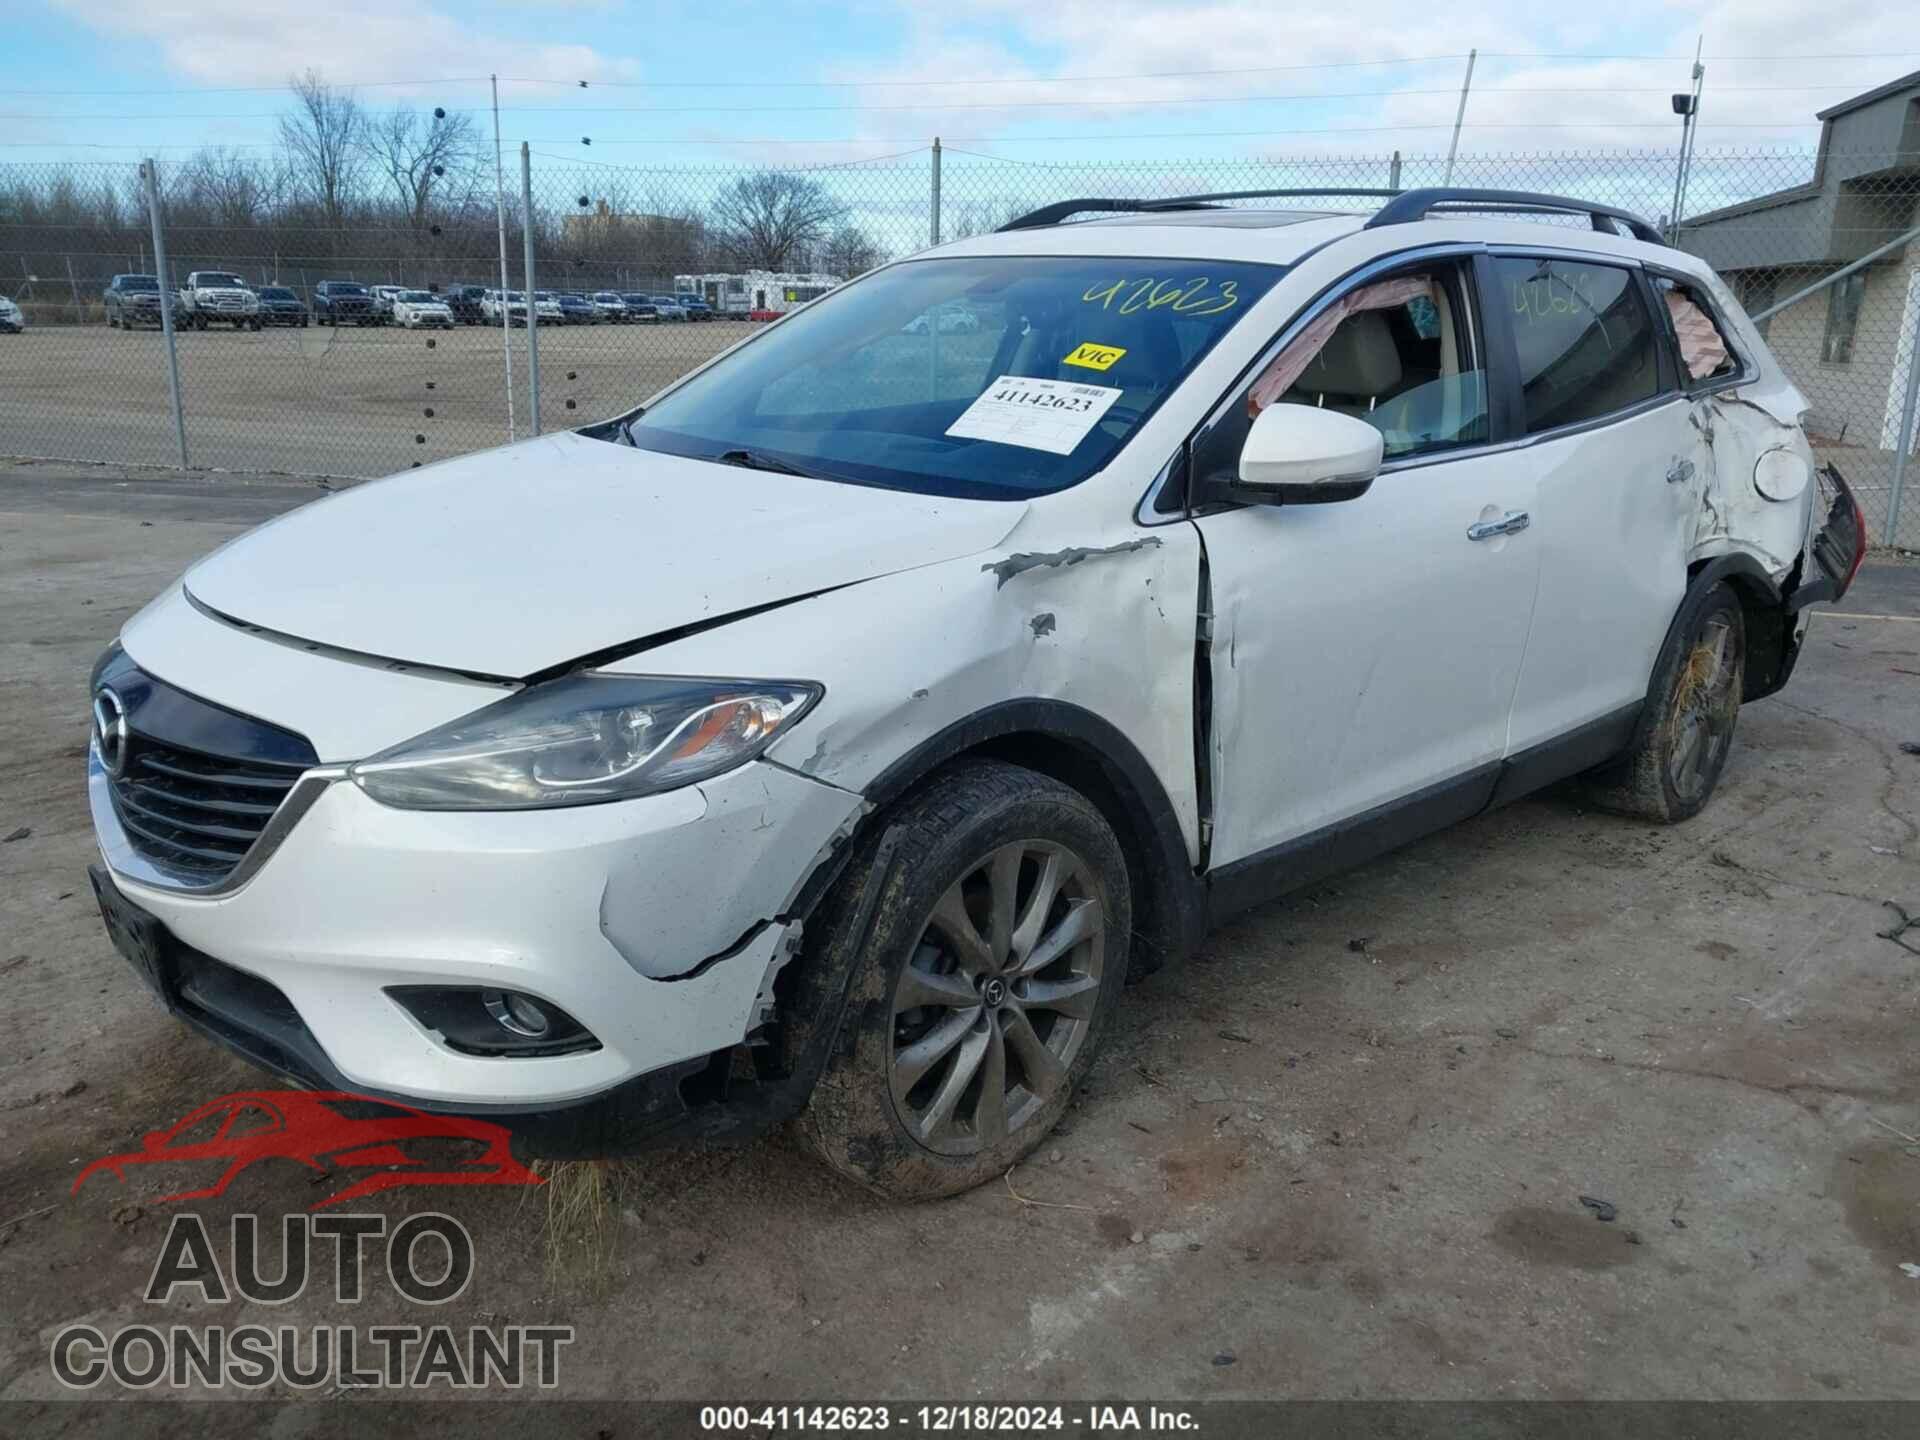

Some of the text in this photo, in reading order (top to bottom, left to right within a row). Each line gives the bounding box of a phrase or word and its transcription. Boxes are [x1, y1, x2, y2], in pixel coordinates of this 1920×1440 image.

[1083, 277, 1238, 316] 42623
[1077, 348, 1117, 365] VIC
[993, 389, 1093, 413] 41142623
